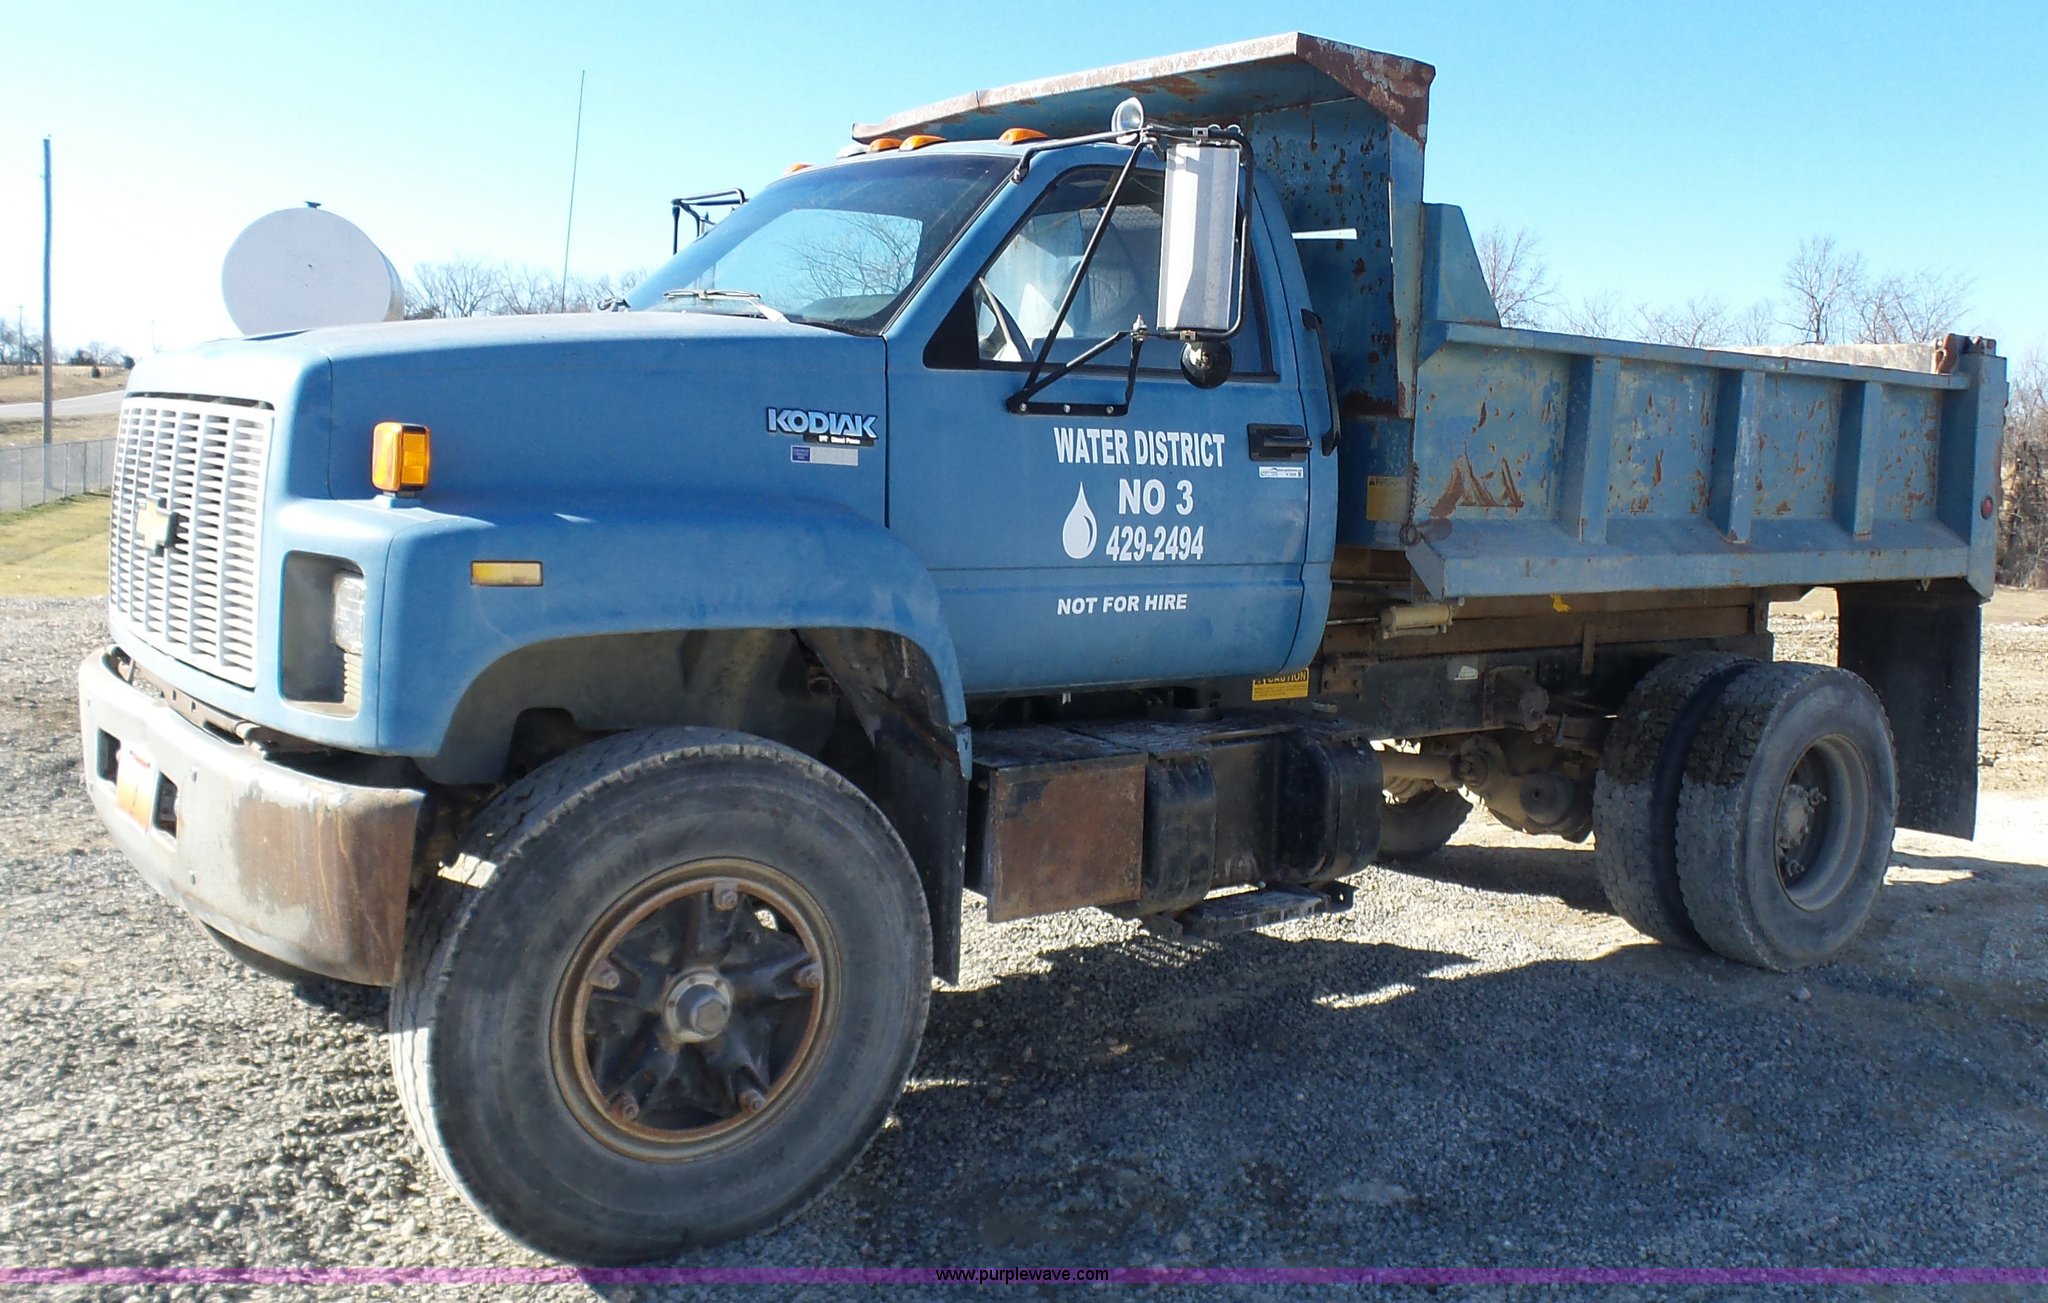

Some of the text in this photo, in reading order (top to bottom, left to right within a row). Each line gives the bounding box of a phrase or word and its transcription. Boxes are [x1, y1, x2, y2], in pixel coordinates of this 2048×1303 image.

[767, 408, 877, 438] KODIAK
[1053, 427, 1226, 467] WATER DISTRICT
[1118, 478, 1194, 515] NO 3
[1105, 525, 1204, 562] 429-2494
[1057, 593, 1188, 615] NOT FOR HIRE
